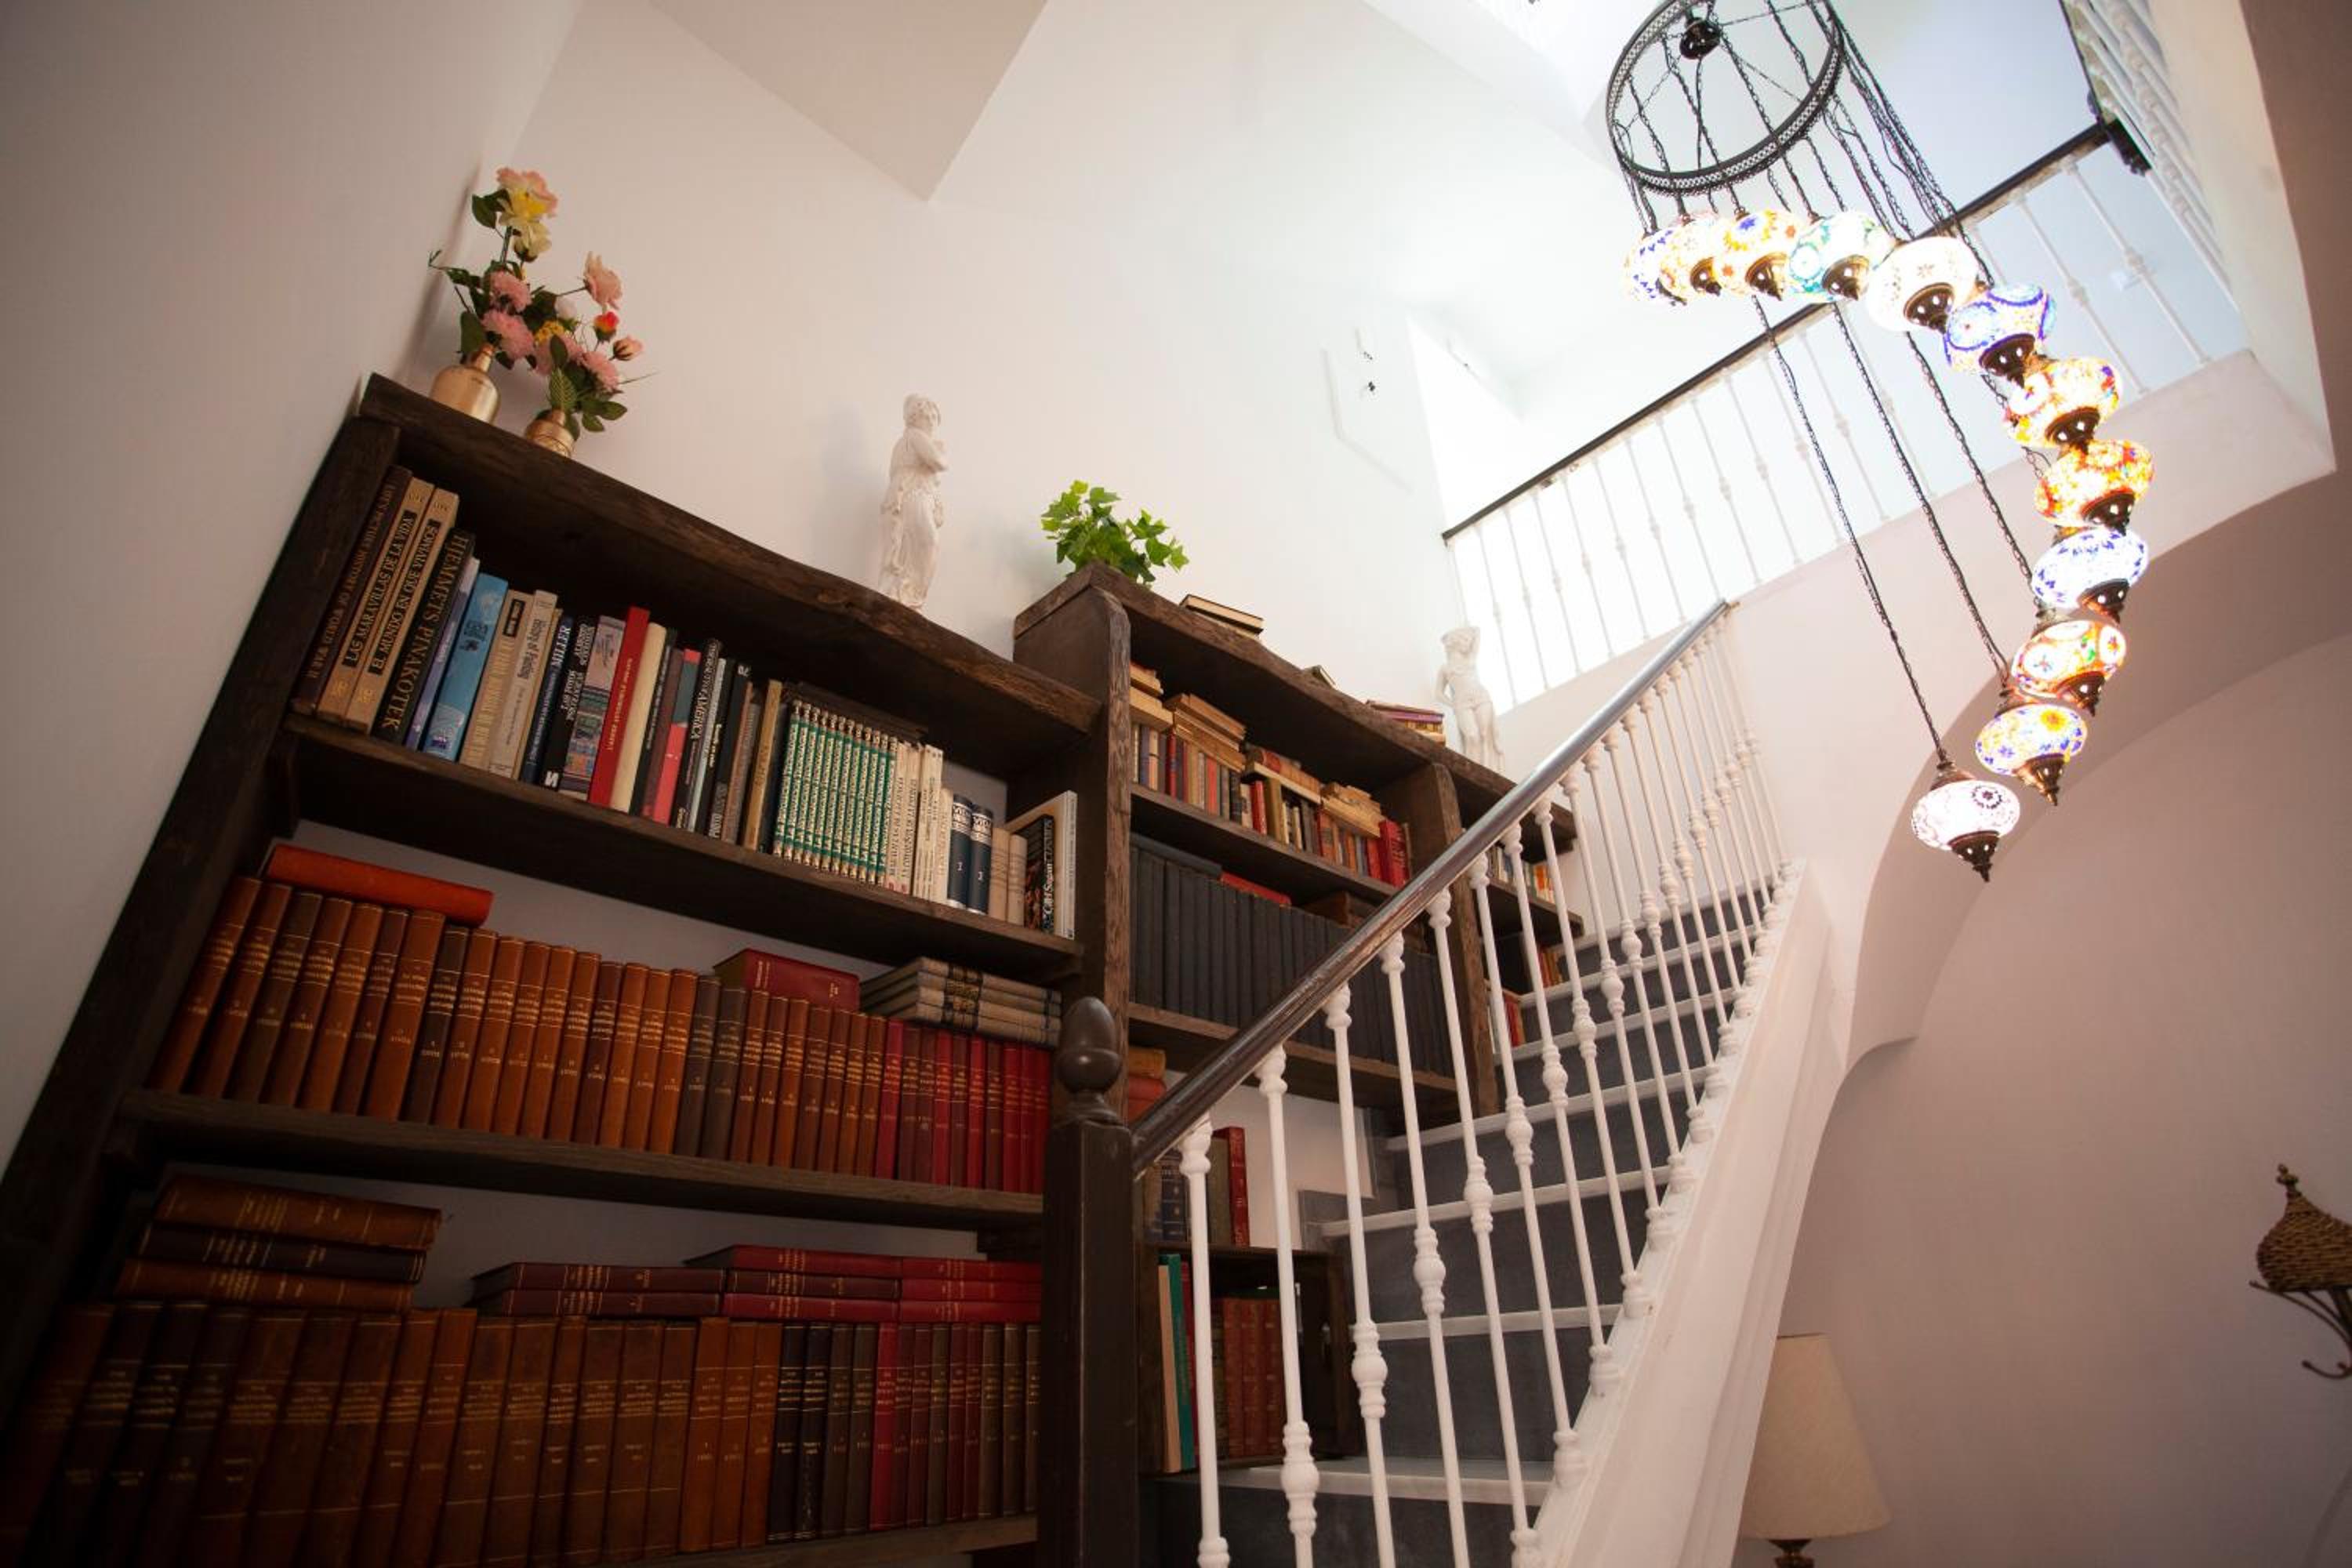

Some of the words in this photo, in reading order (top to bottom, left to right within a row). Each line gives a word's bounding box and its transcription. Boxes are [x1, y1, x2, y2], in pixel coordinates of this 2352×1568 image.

[378, 610, 405, 655] MUNDO
[551, 625, 572, 668] MILLER
[379, 622, 436, 733] PINAKOTEK
